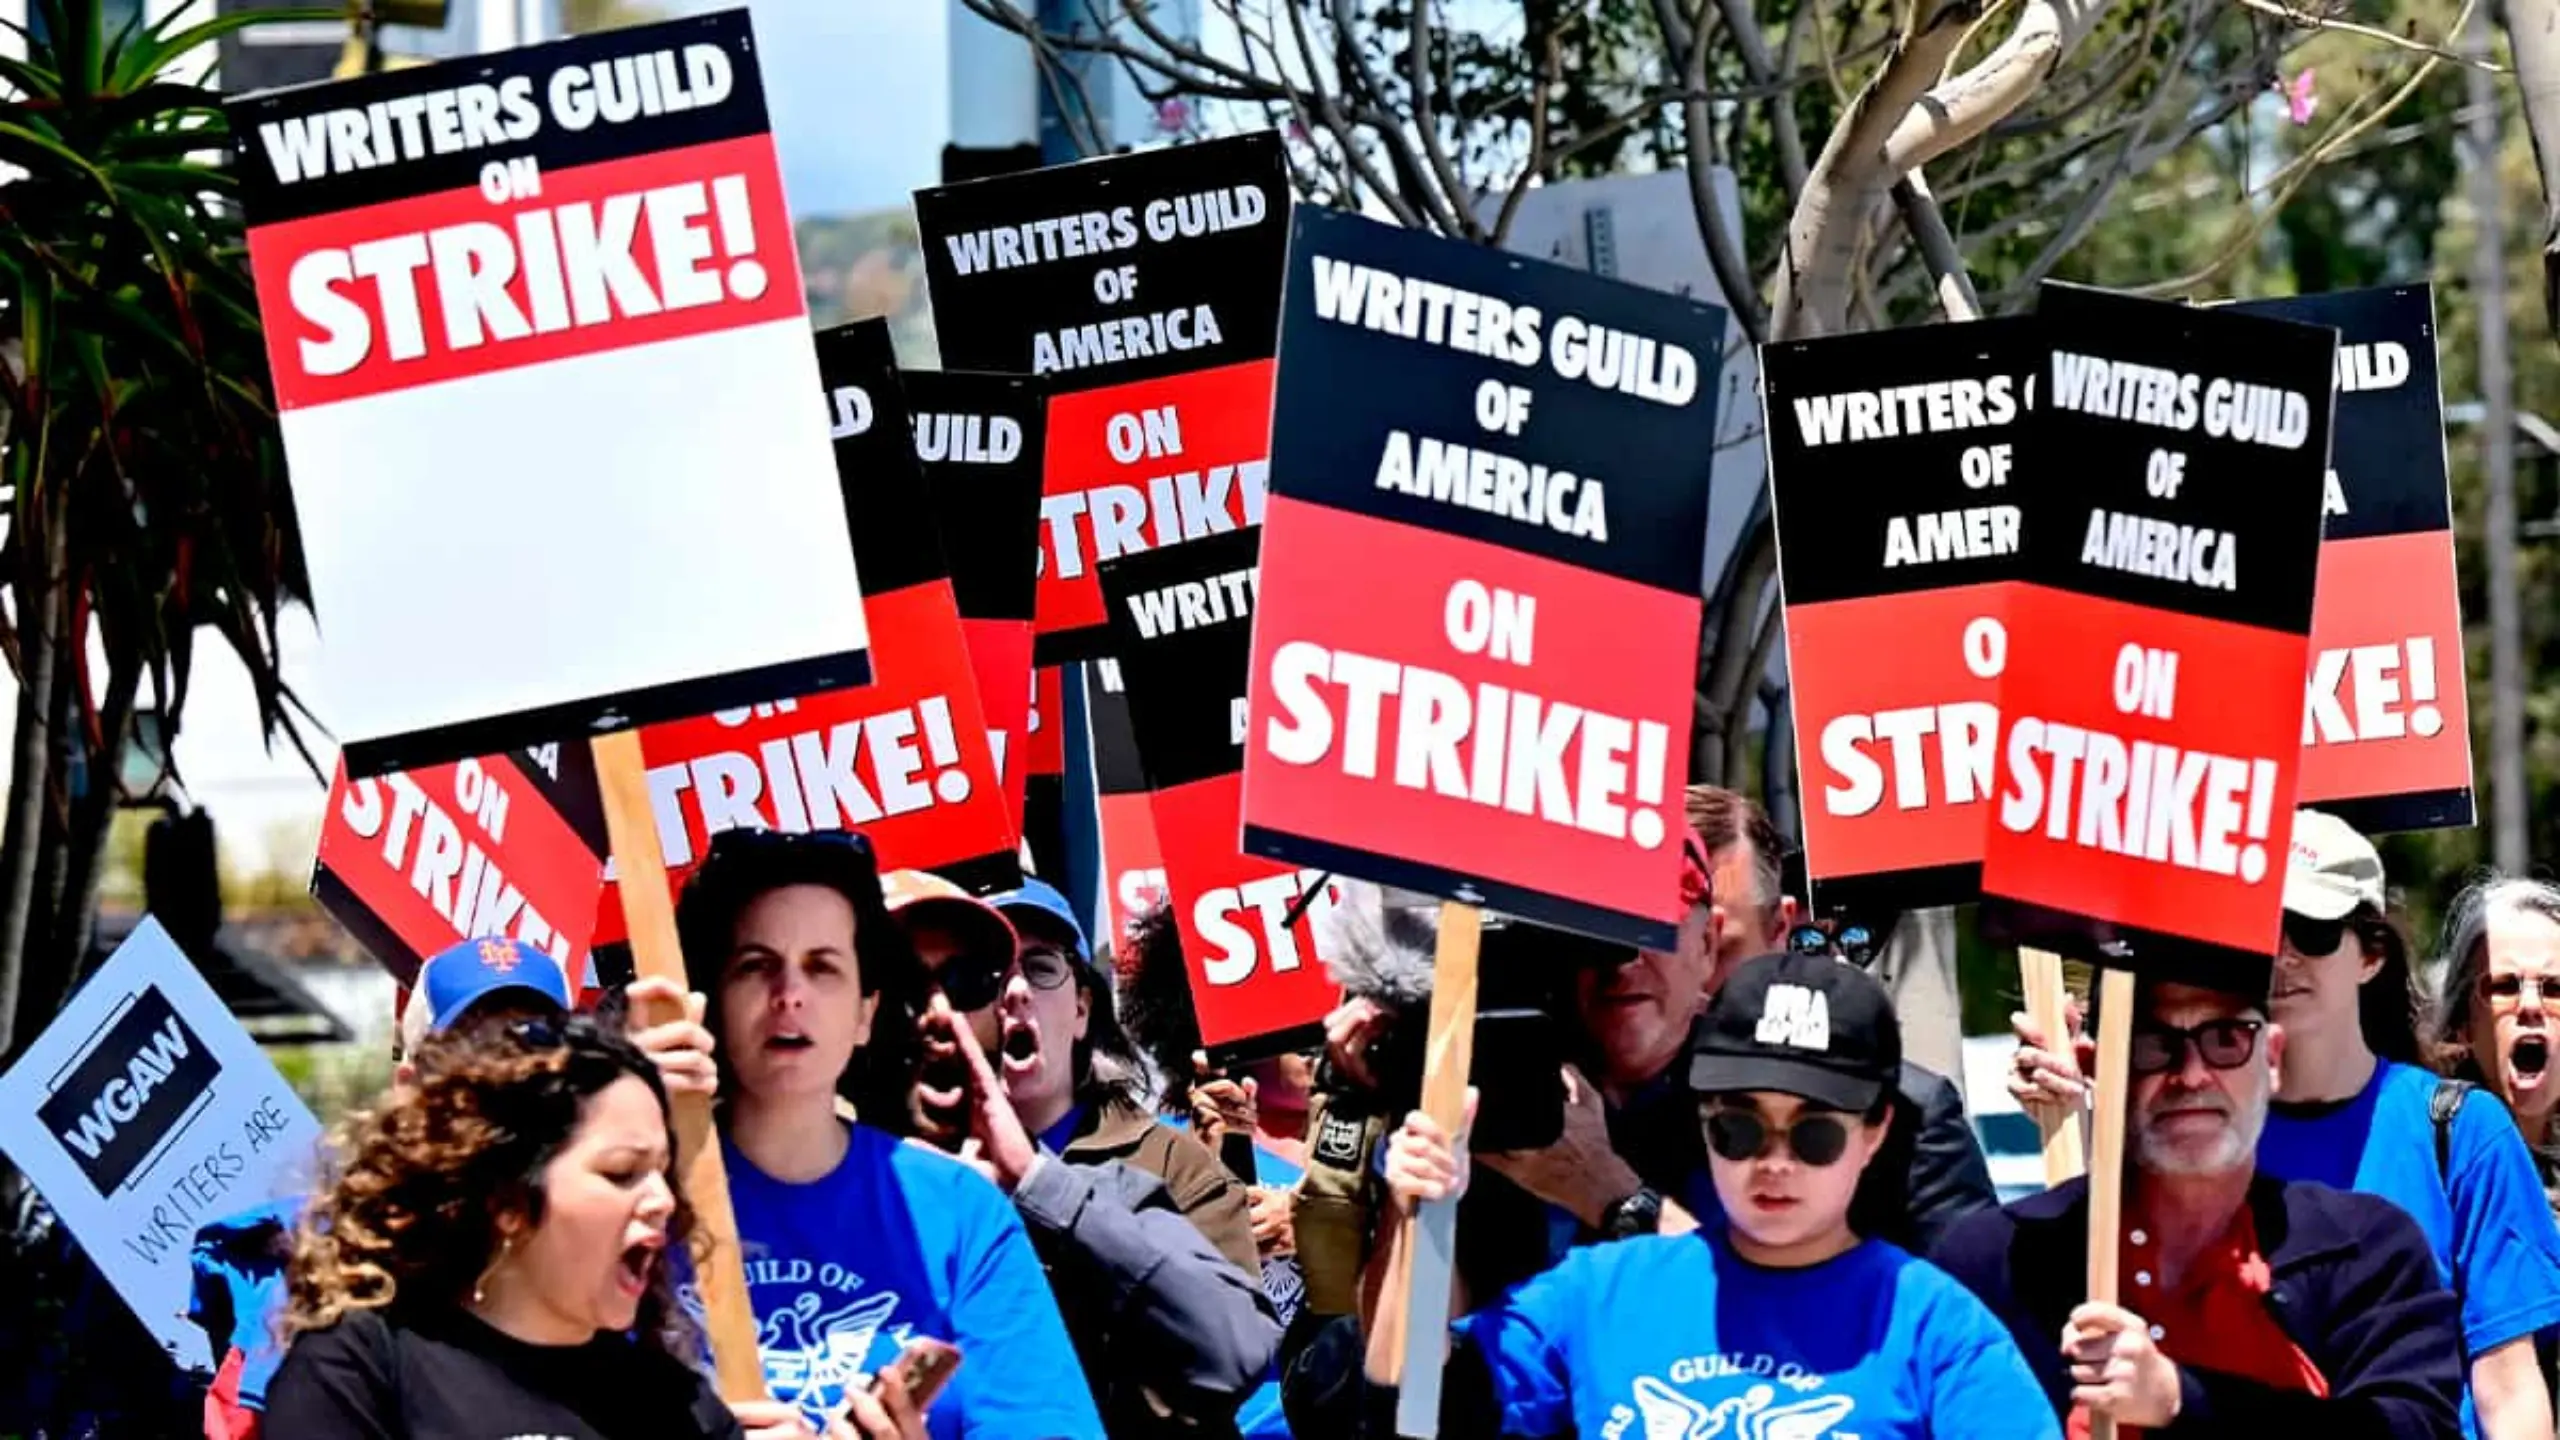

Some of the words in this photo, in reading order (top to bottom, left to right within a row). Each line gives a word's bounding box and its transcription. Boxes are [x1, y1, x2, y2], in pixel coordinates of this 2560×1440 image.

[258, 75, 541, 185] WRITERS
[547, 43, 733, 132] GUILD
[479, 154, 541, 205] ON
[945, 206, 1138, 275] WRITERS
[1145, 184, 1266, 243] GUILD
[287, 173, 769, 378] STRIKE!
[1094, 264, 1138, 304] OF
[1033, 304, 1223, 375] AMERICA
[1312, 256, 1541, 368] WRITERS
[1549, 315, 1697, 407] GUILD
[2333, 341, 2411, 393] ILD
[910, 413, 1022, 464] UILD
[1106, 405, 1182, 464] ON
[1475, 377, 1532, 437] OF
[1794, 374, 2017, 447] WRITERS
[2051, 350, 2199, 431] WRITERS
[2202, 371, 2310, 449] GUILD
[1375, 431, 1607, 543] AMERICA
[1960, 444, 2013, 489] OF
[2146, 448, 2186, 499] OF
[1037, 458, 1270, 580] TRIK
[1883, 504, 2022, 568] AMER
[2080, 508, 2237, 592] AMERICA
[1126, 566, 1260, 641] WRIT
[1444, 578, 1536, 666] ON
[1962, 616, 2008, 679] O
[2113, 642, 2179, 720] ON
[2301, 635, 2444, 748] KE!
[605, 694, 972, 868] TRIKE!
[1266, 640, 1669, 851] STRIKE!
[1820, 701, 2000, 818] STR
[455, 757, 510, 846] ON
[1999, 716, 2278, 886] STRIKE!
[62, 1015, 190, 1161] WGAW
[122, 1139, 246, 1268] WRITERS
[245, 1094, 292, 1158] ARE
[818, 1261, 866, 1293] OF
[1669, 1351, 1775, 1384] GUILD
